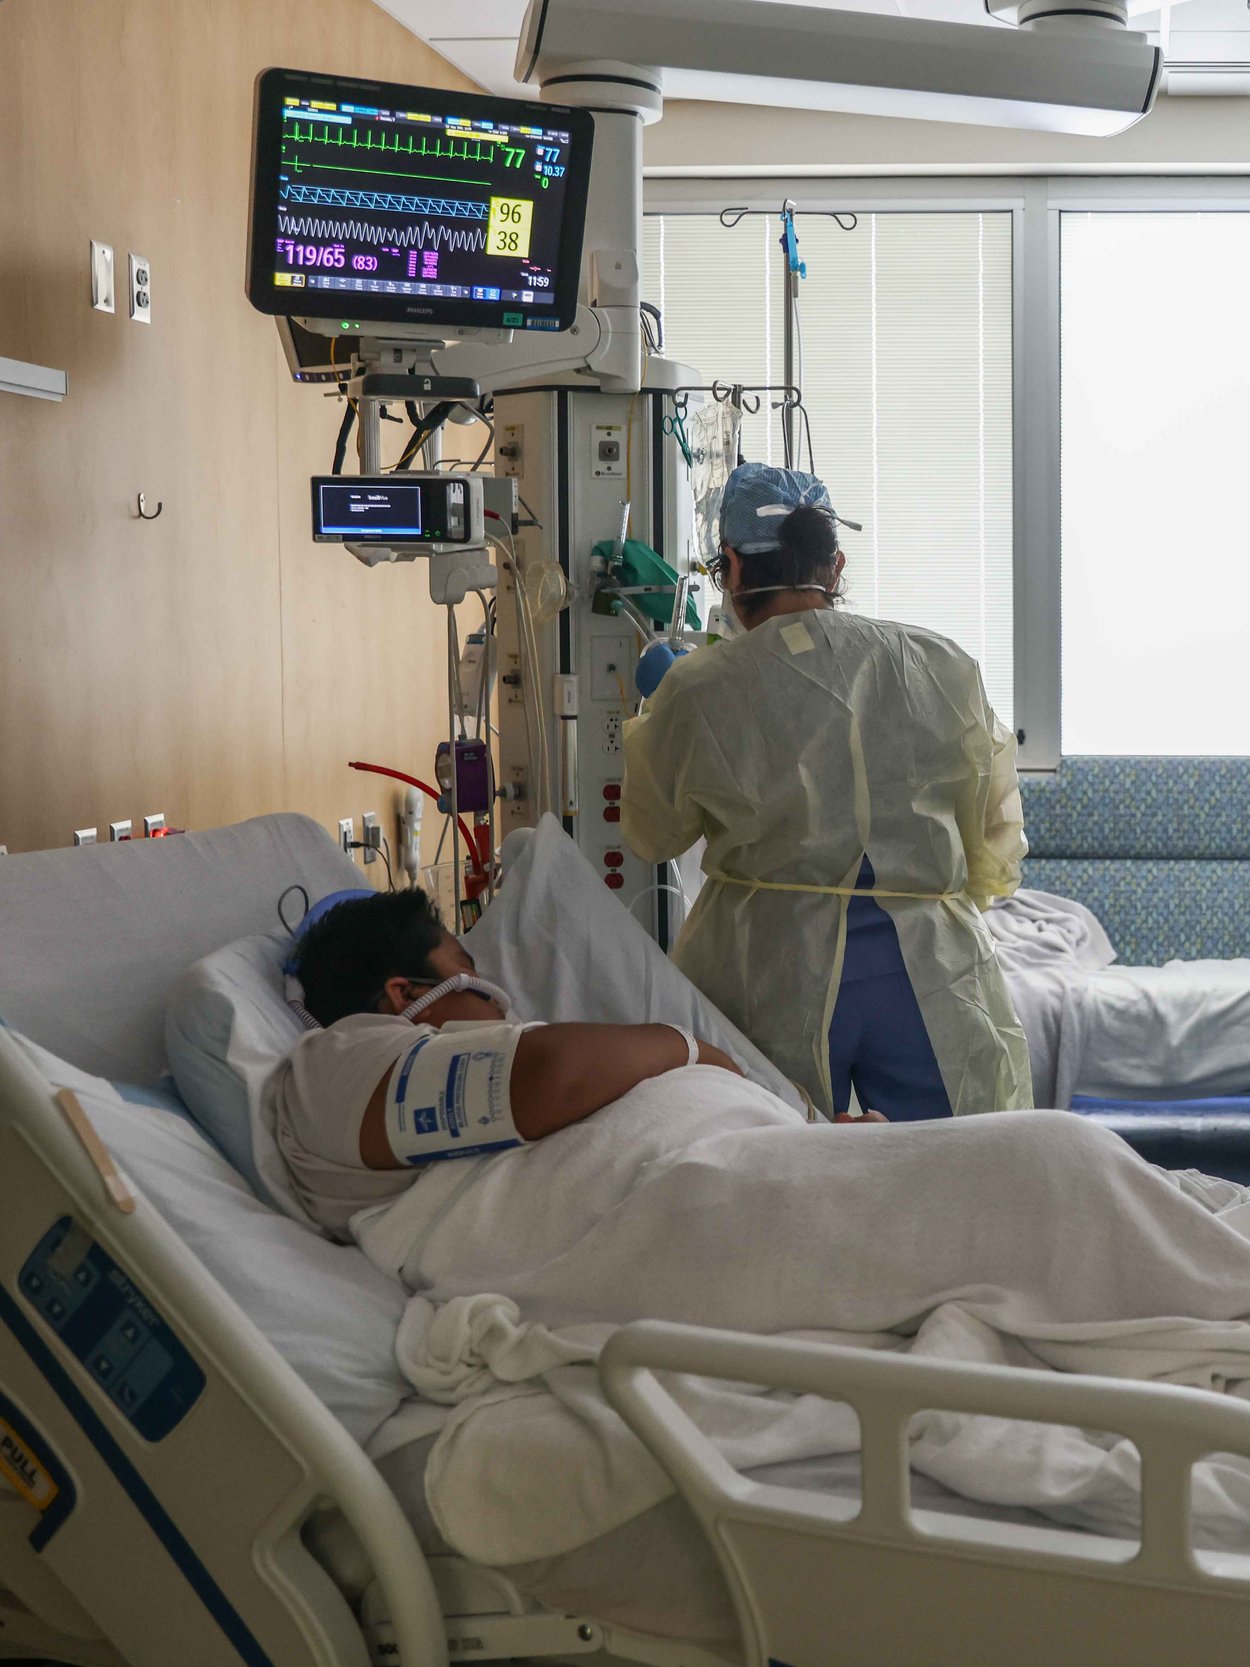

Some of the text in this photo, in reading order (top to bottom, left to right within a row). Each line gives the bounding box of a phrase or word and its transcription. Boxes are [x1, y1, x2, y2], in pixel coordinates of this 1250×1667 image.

[504, 147, 560, 169] 77 77
[543, 165, 565, 178] 10.37
[541, 177, 549, 190] 0
[499, 202, 522, 224] 96
[496, 230, 519, 251] 38
[285, 244, 378, 271] 119/65 (83)
[406, 307, 433, 315] PHILIPS
[1, 1434, 37, 1485] PULL
